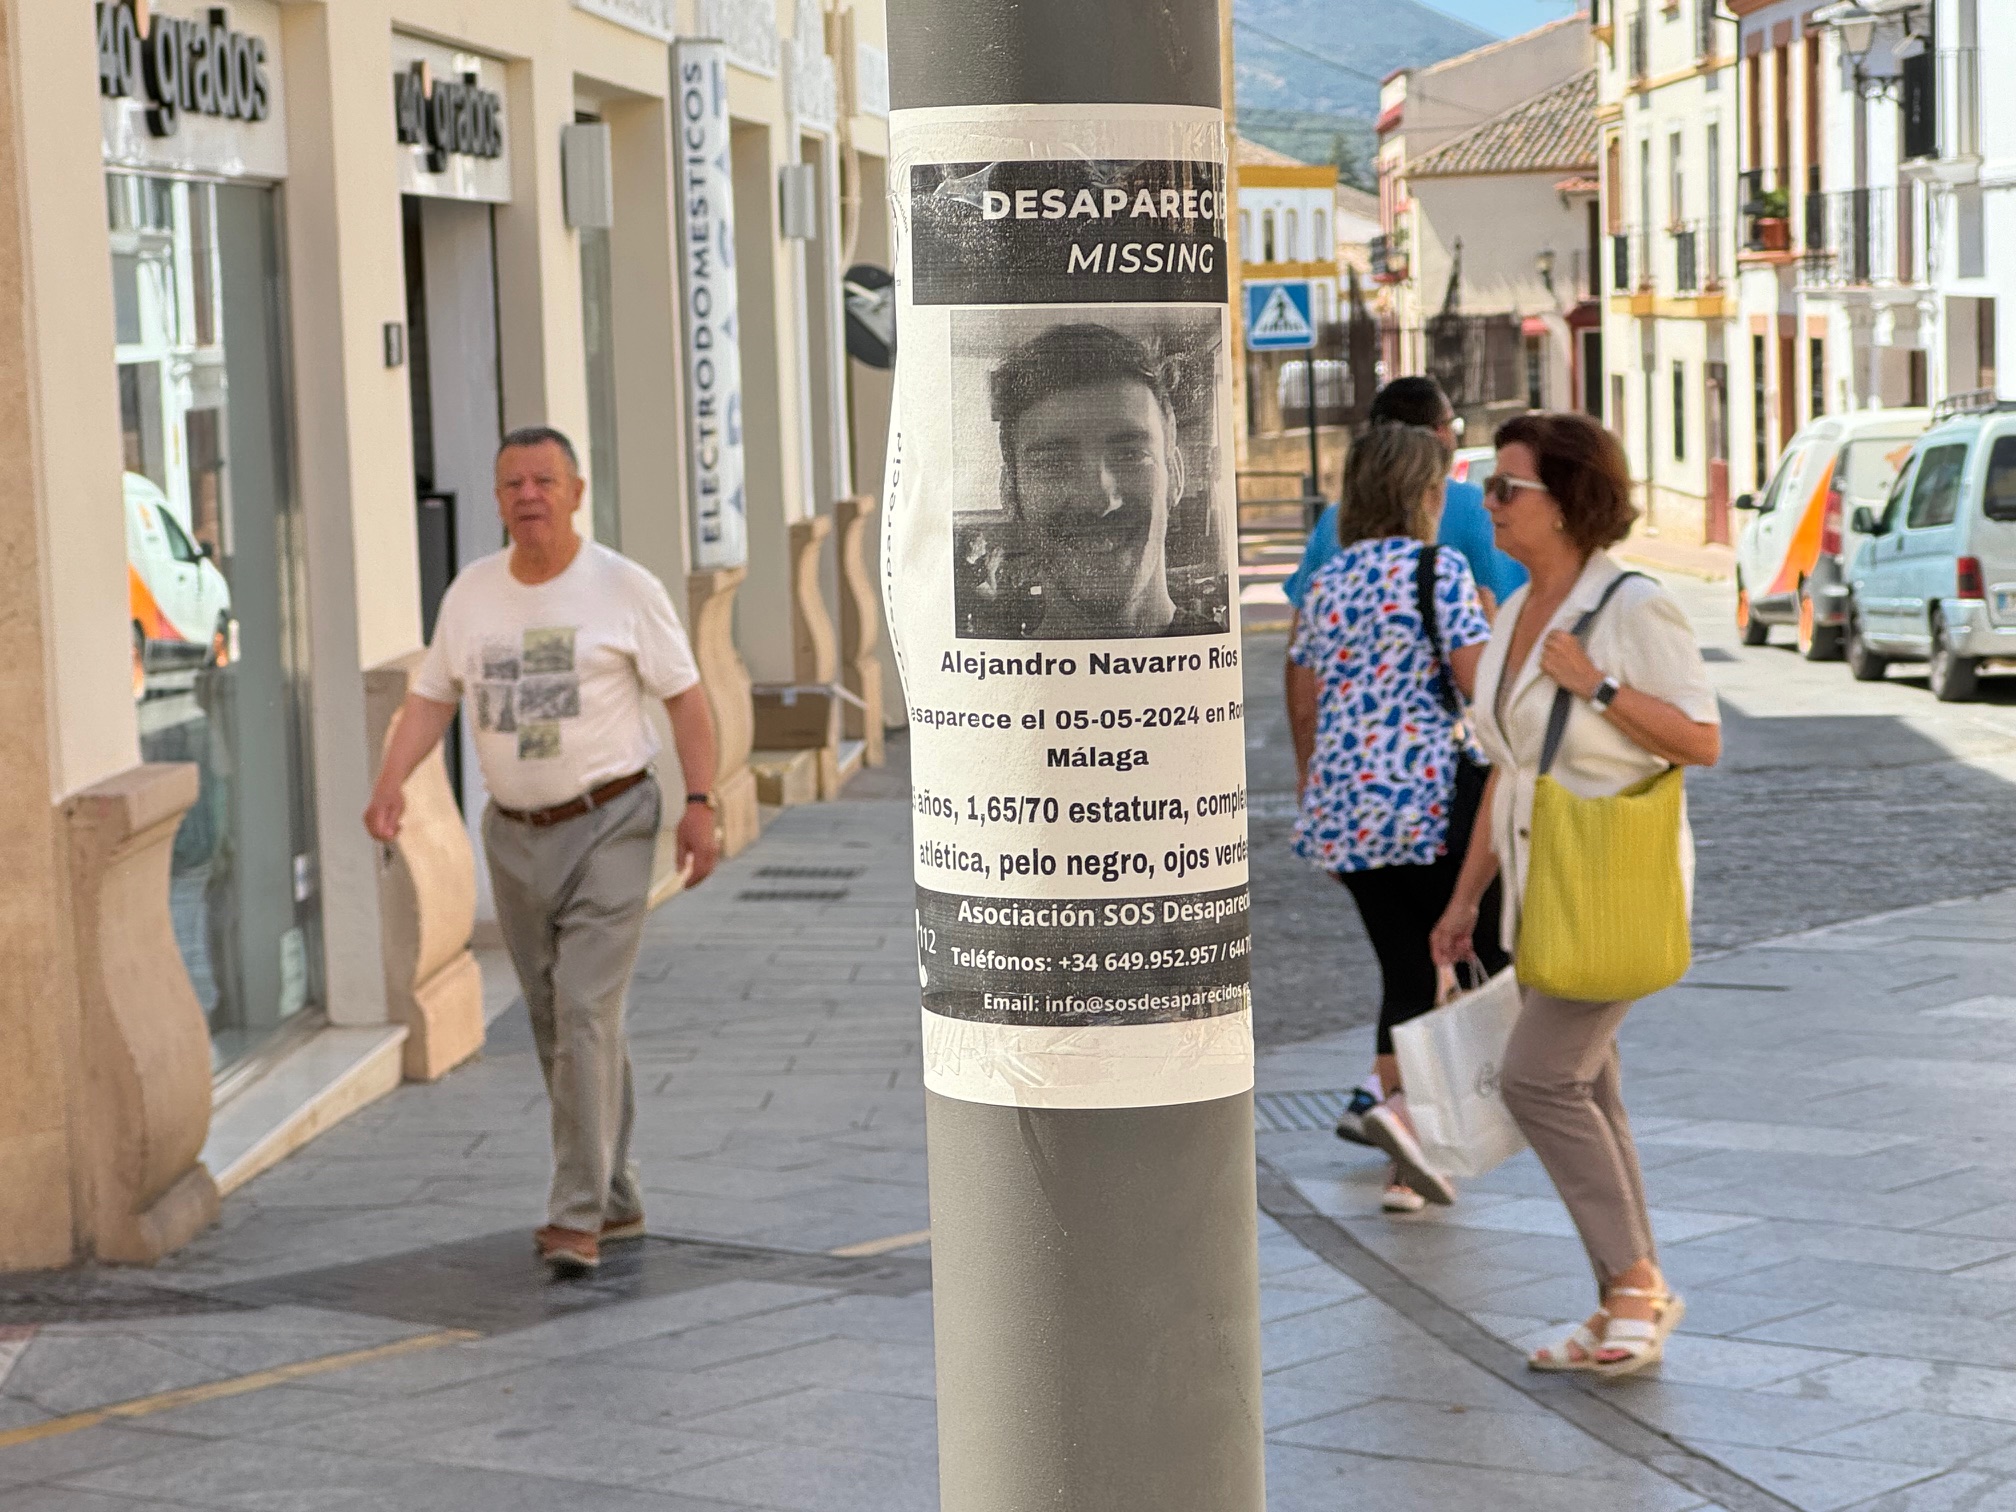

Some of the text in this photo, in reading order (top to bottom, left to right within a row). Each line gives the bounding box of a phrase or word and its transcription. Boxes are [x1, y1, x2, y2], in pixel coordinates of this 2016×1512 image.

[150, 8, 269, 137] grados
[432, 73, 502, 173] grados
[1067, 243, 1214, 274] MISSING
[682, 63, 720, 543] ELECTRODOMESTICOS
[941, 645, 1238, 681] Alejandro Navarro Ríos
[1021, 709, 1046, 730] el
[1055, 705, 1200, 730] 05-05-2024
[1205, 706, 1225, 723] en
[1047, 746, 1150, 772] Málaga
[918, 788, 959, 826] años,
[967, 795, 1059, 828] 1,65/70
[1068, 796, 1190, 826] estatura,
[920, 840, 990, 880] atlética,
[1000, 847, 1057, 882] pelo
[1066, 850, 1155, 883] negro,
[1164, 844, 1210, 879] ojos
[958, 900, 1095, 928] Asociación
[1103, 903, 1155, 927] SOS
[920, 925, 937, 954] 112
[950, 946, 1052, 973] Teléfonos:
[1058, 952, 1099, 973] +34
[1104, 944, 1218, 971] 649.952.957
[1220, 942, 1227, 961] /
[983, 993, 1039, 1013] Email:
